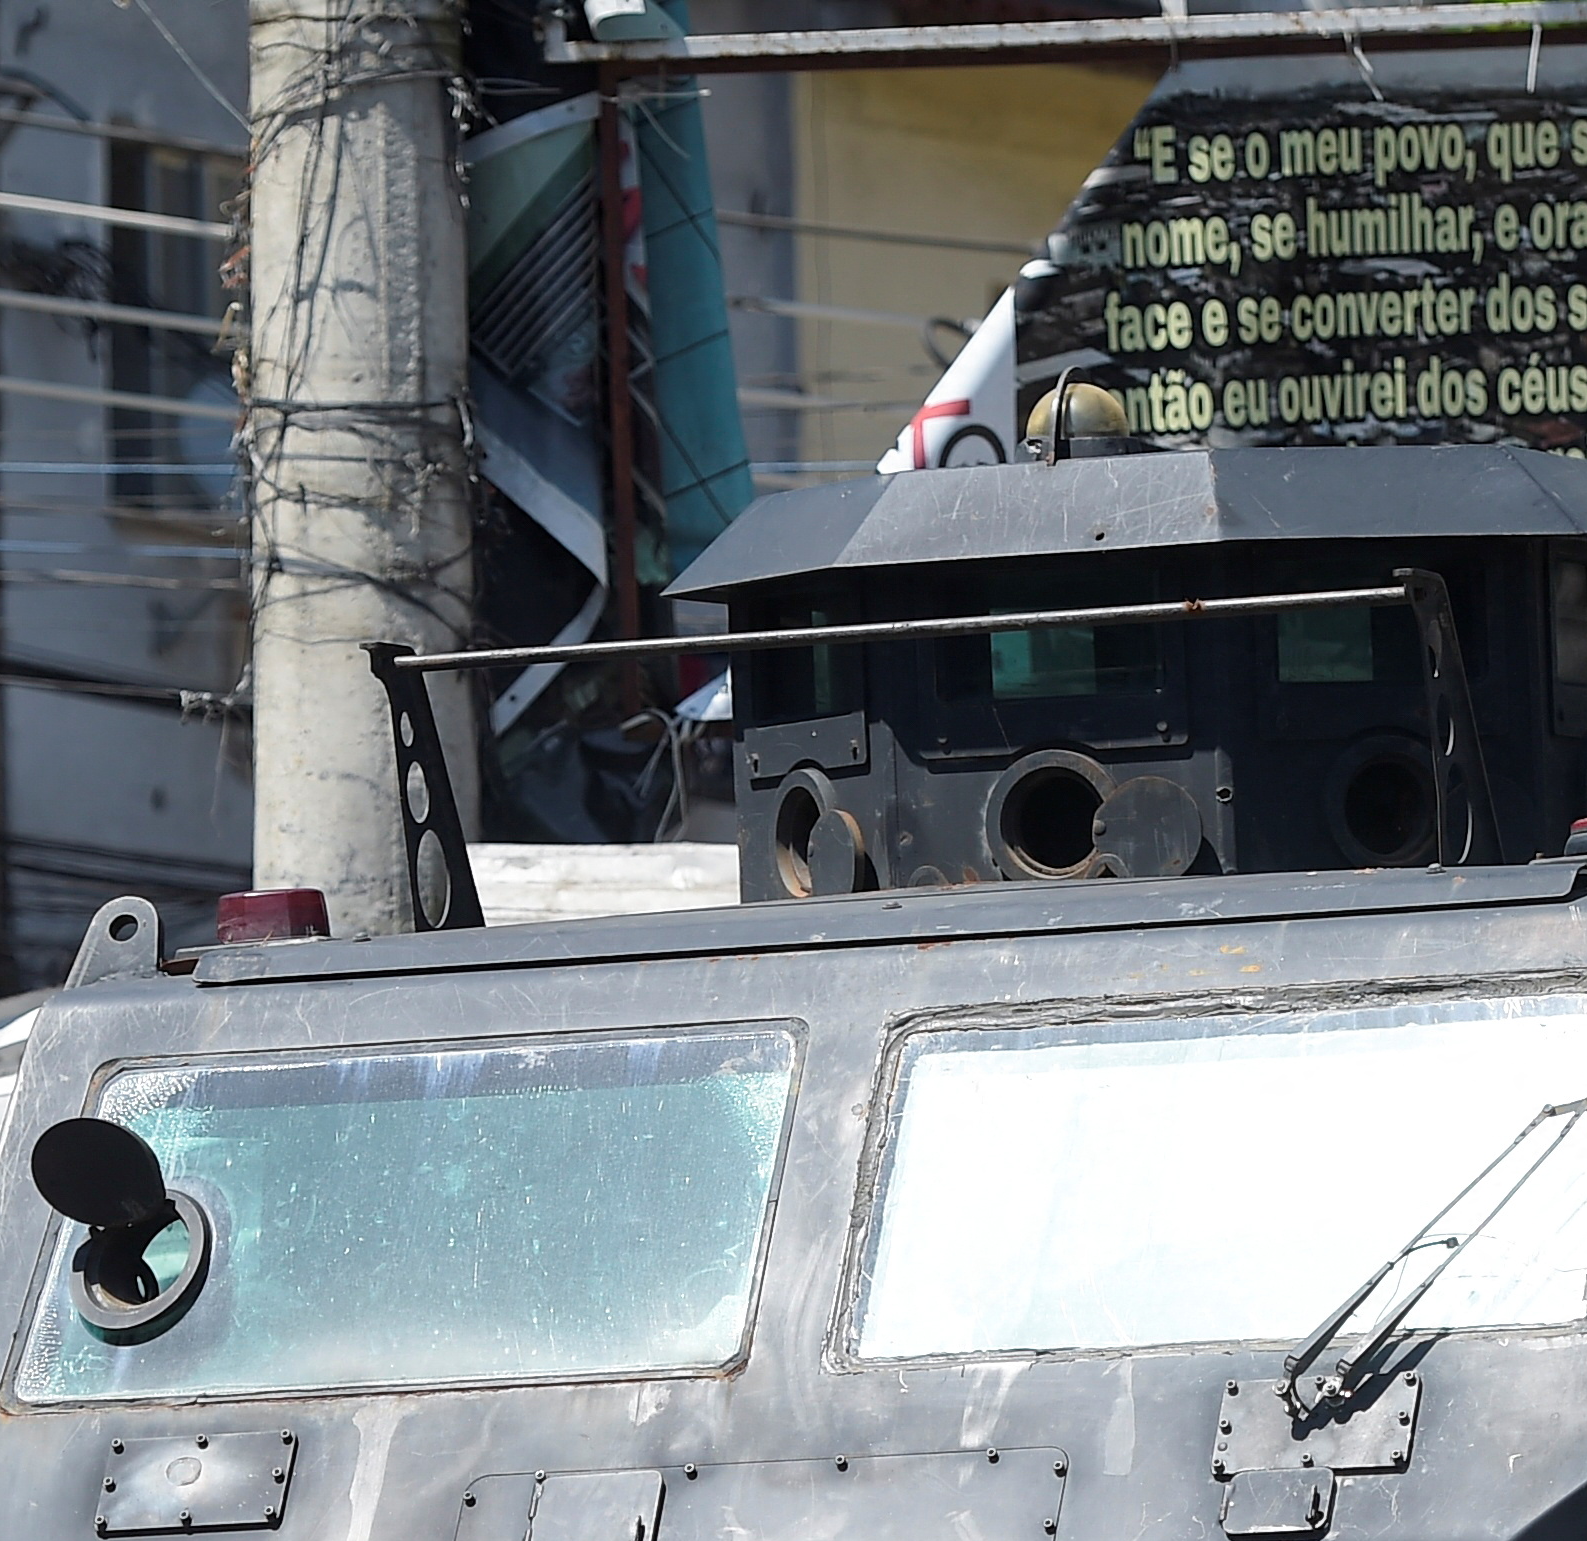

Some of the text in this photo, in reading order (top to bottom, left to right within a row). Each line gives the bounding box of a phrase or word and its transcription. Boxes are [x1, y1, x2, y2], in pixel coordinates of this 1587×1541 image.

[1188, 133, 1235, 182] se
[1245, 131, 1270, 178] o
[1280, 126, 1362, 176] meu
[1374, 121, 1477, 187] povo,
[1486, 119, 1560, 183] que
[1122, 216, 1242, 276] nome,
[1250, 212, 1297, 261] se
[1307, 193, 1484, 265] humilhar,
[1494, 203, 1519, 251] e
[1105, 292, 1193, 352] face
[1202, 299, 1229, 347] e
[1237, 296, 1283, 344] se
[1291, 277, 1477, 342] converter
[1486, 272, 1557, 334] dos
[1223, 378, 1271, 427] eu
[1278, 357, 1406, 422] ouvirei
[1416, 355, 1488, 418] dos
